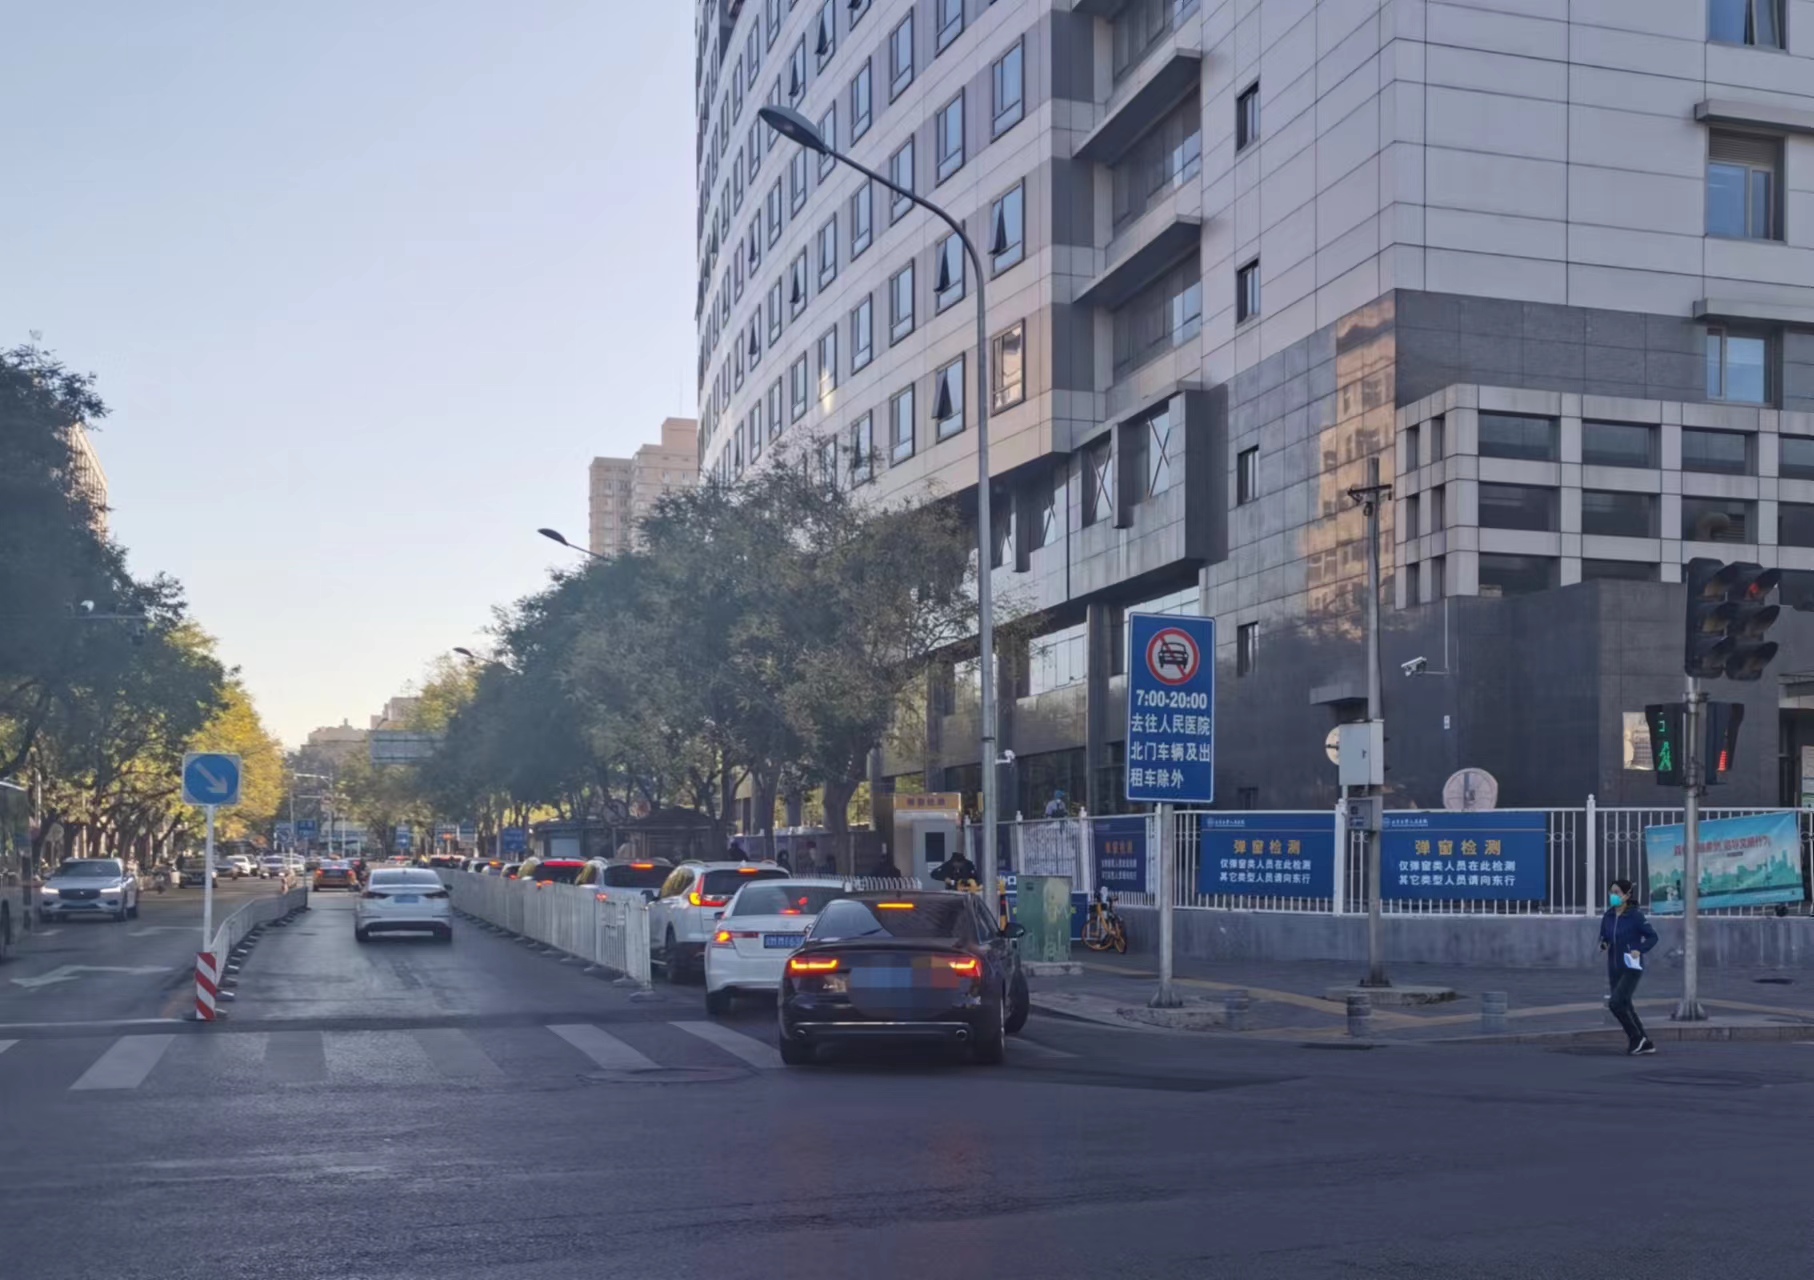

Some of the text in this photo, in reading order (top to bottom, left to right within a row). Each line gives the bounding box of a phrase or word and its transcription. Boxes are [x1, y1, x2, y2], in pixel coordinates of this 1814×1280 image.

[1136, 689, 1208, 710] 7:00-20:00
[1130, 713, 1211, 736] 去往人民医院
[1130, 741, 1211, 763] 北门车辆及出
[1129, 768, 1185, 789] 租车除外
[1233, 839, 1301, 855] 弹窗检测
[1415, 839, 1501, 856] 弹窗检测
[1399, 859, 1516, 872] 仅弹窗类人员在此检测
[1399, 874, 1516, 886] 其它类型人员请向东行
